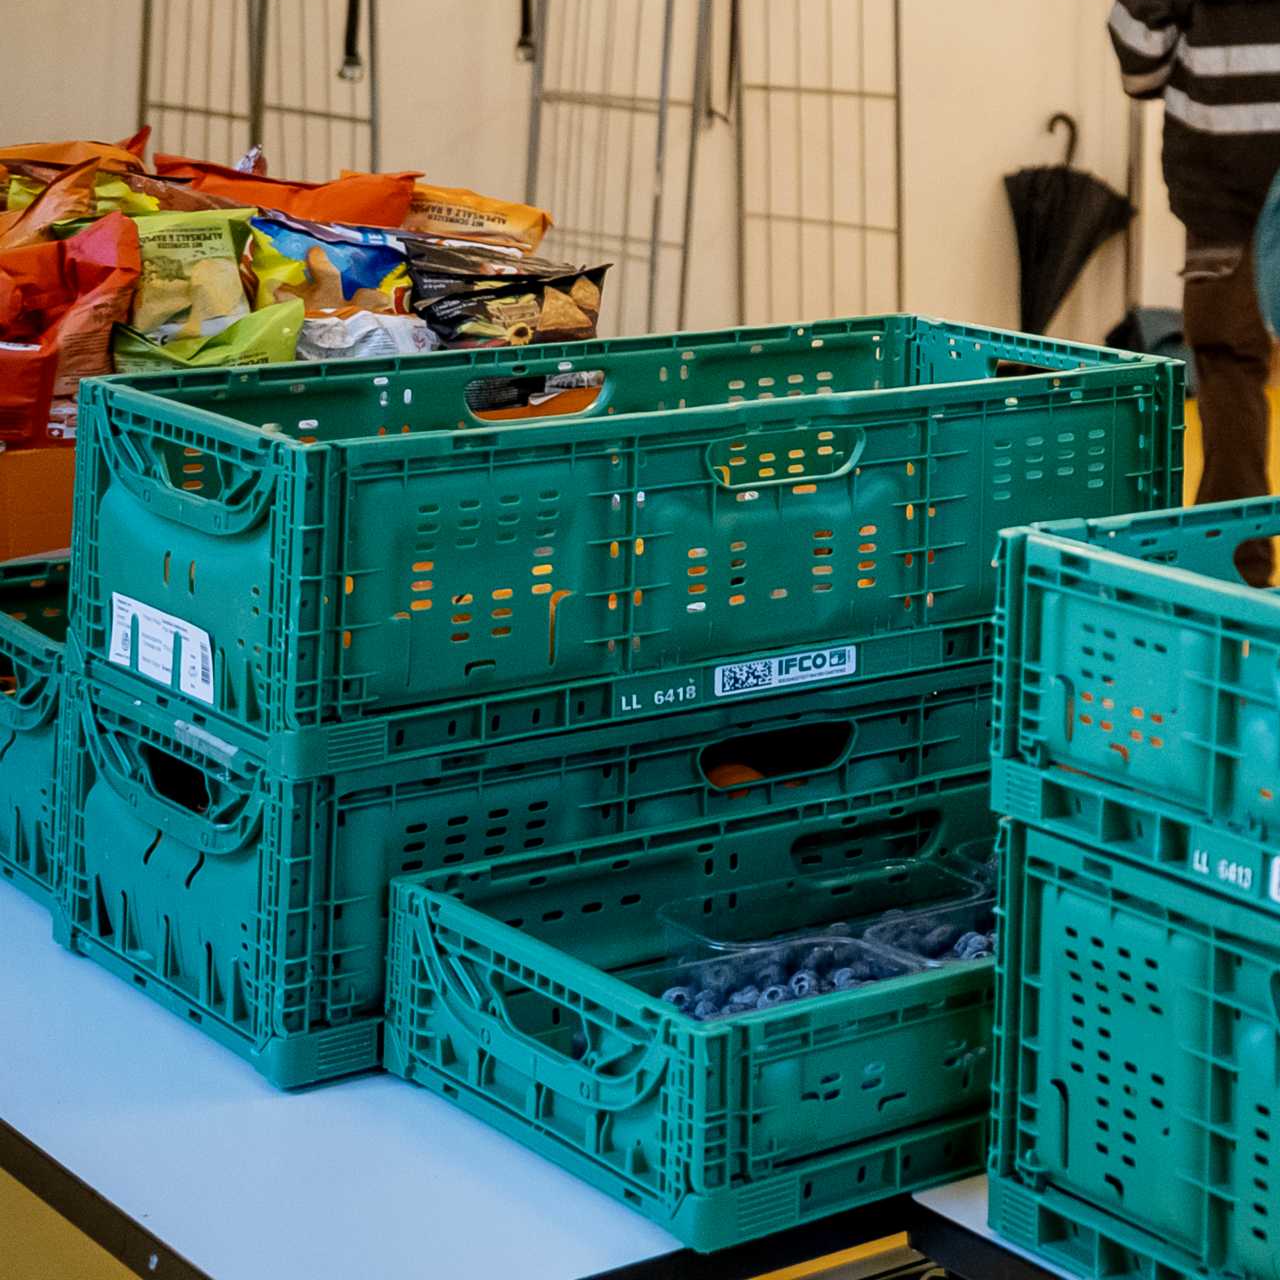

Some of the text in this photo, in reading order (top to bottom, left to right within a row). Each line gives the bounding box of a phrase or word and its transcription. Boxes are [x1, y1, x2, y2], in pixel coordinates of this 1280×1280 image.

[778, 652, 827, 676] IFCO
[621, 685, 696, 711] LL 6418
[1193, 849, 1252, 889] LL 6413
